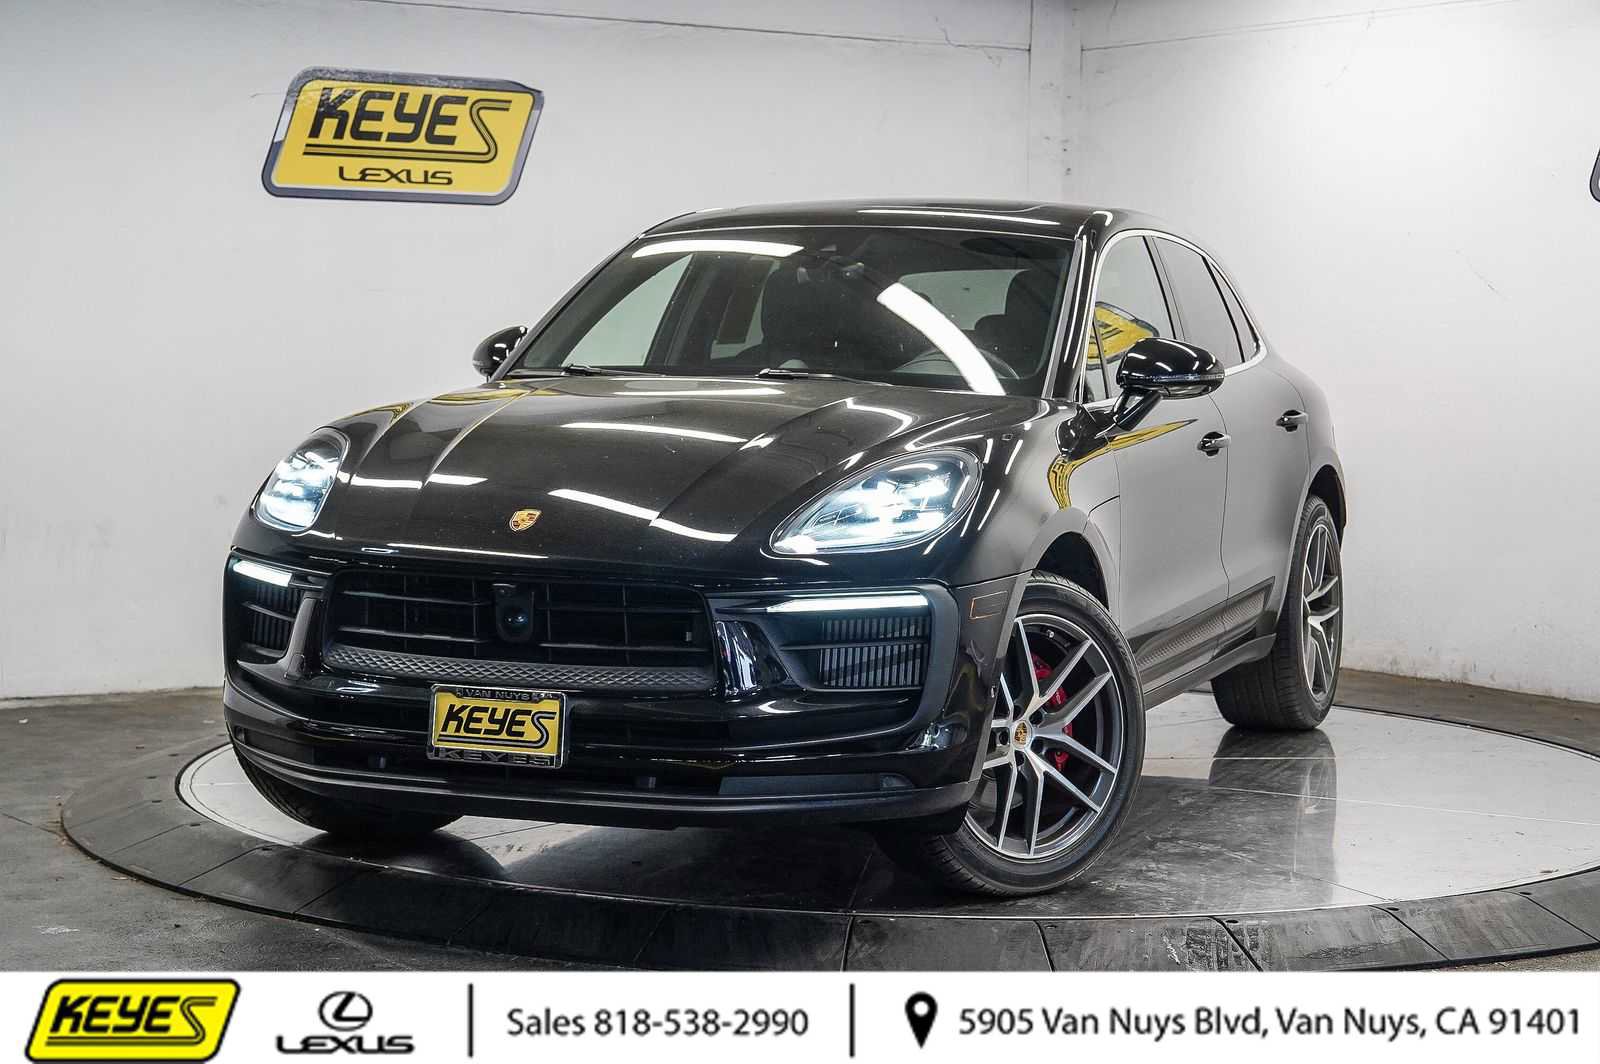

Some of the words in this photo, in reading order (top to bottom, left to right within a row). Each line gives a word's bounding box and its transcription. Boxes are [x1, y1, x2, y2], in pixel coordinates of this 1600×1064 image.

[303, 87, 512, 163] KEYES
[339, 166, 453, 185] LEXUS
[466, 689, 491, 698] VAN
[495, 691, 529, 700] NUYS
[437, 703, 557, 748] KEYES
[439, 748, 551, 767] KEYES
